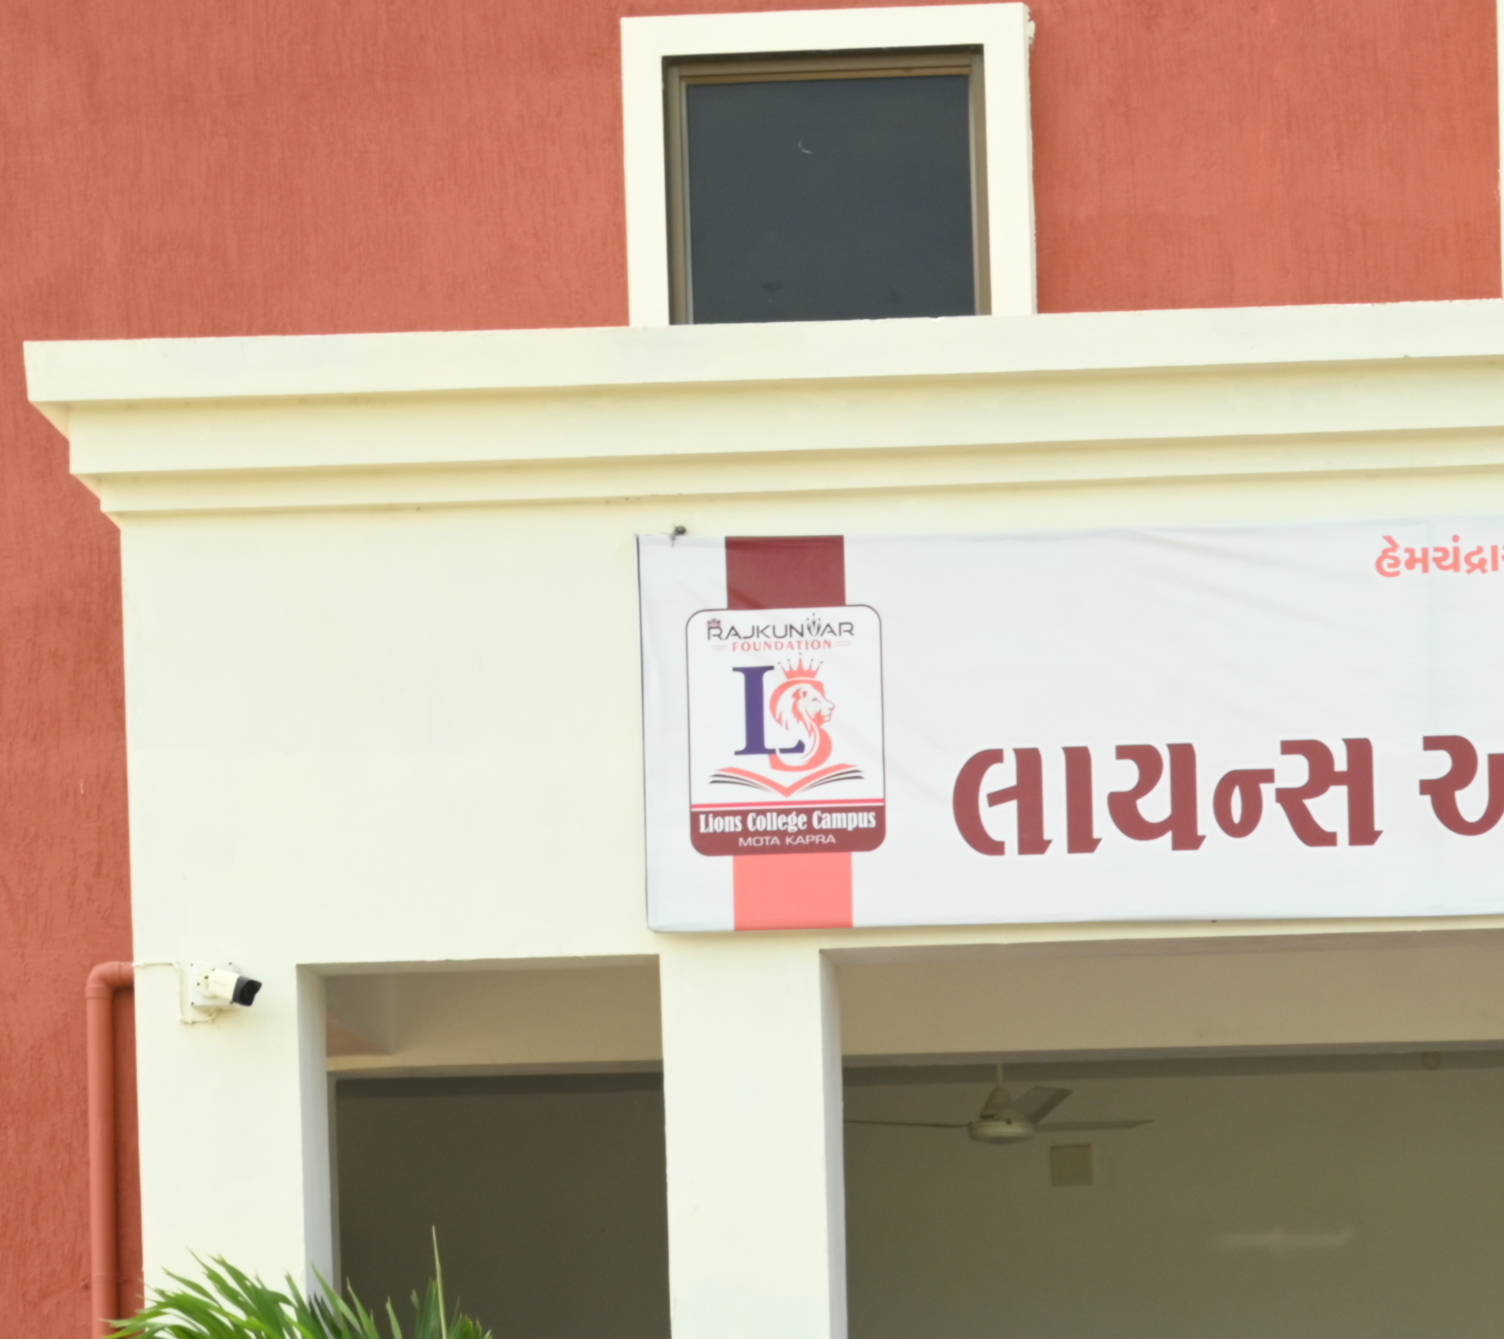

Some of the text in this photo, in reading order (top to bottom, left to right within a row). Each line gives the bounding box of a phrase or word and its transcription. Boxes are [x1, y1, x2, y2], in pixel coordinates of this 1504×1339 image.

[732, 639, 833, 653] FOUNDATION
[952, 738, 1383, 856] લાયન્સ
[699, 810, 877, 833] Lions College Campus
[738, 834, 836, 847] MOTA KAPRA
